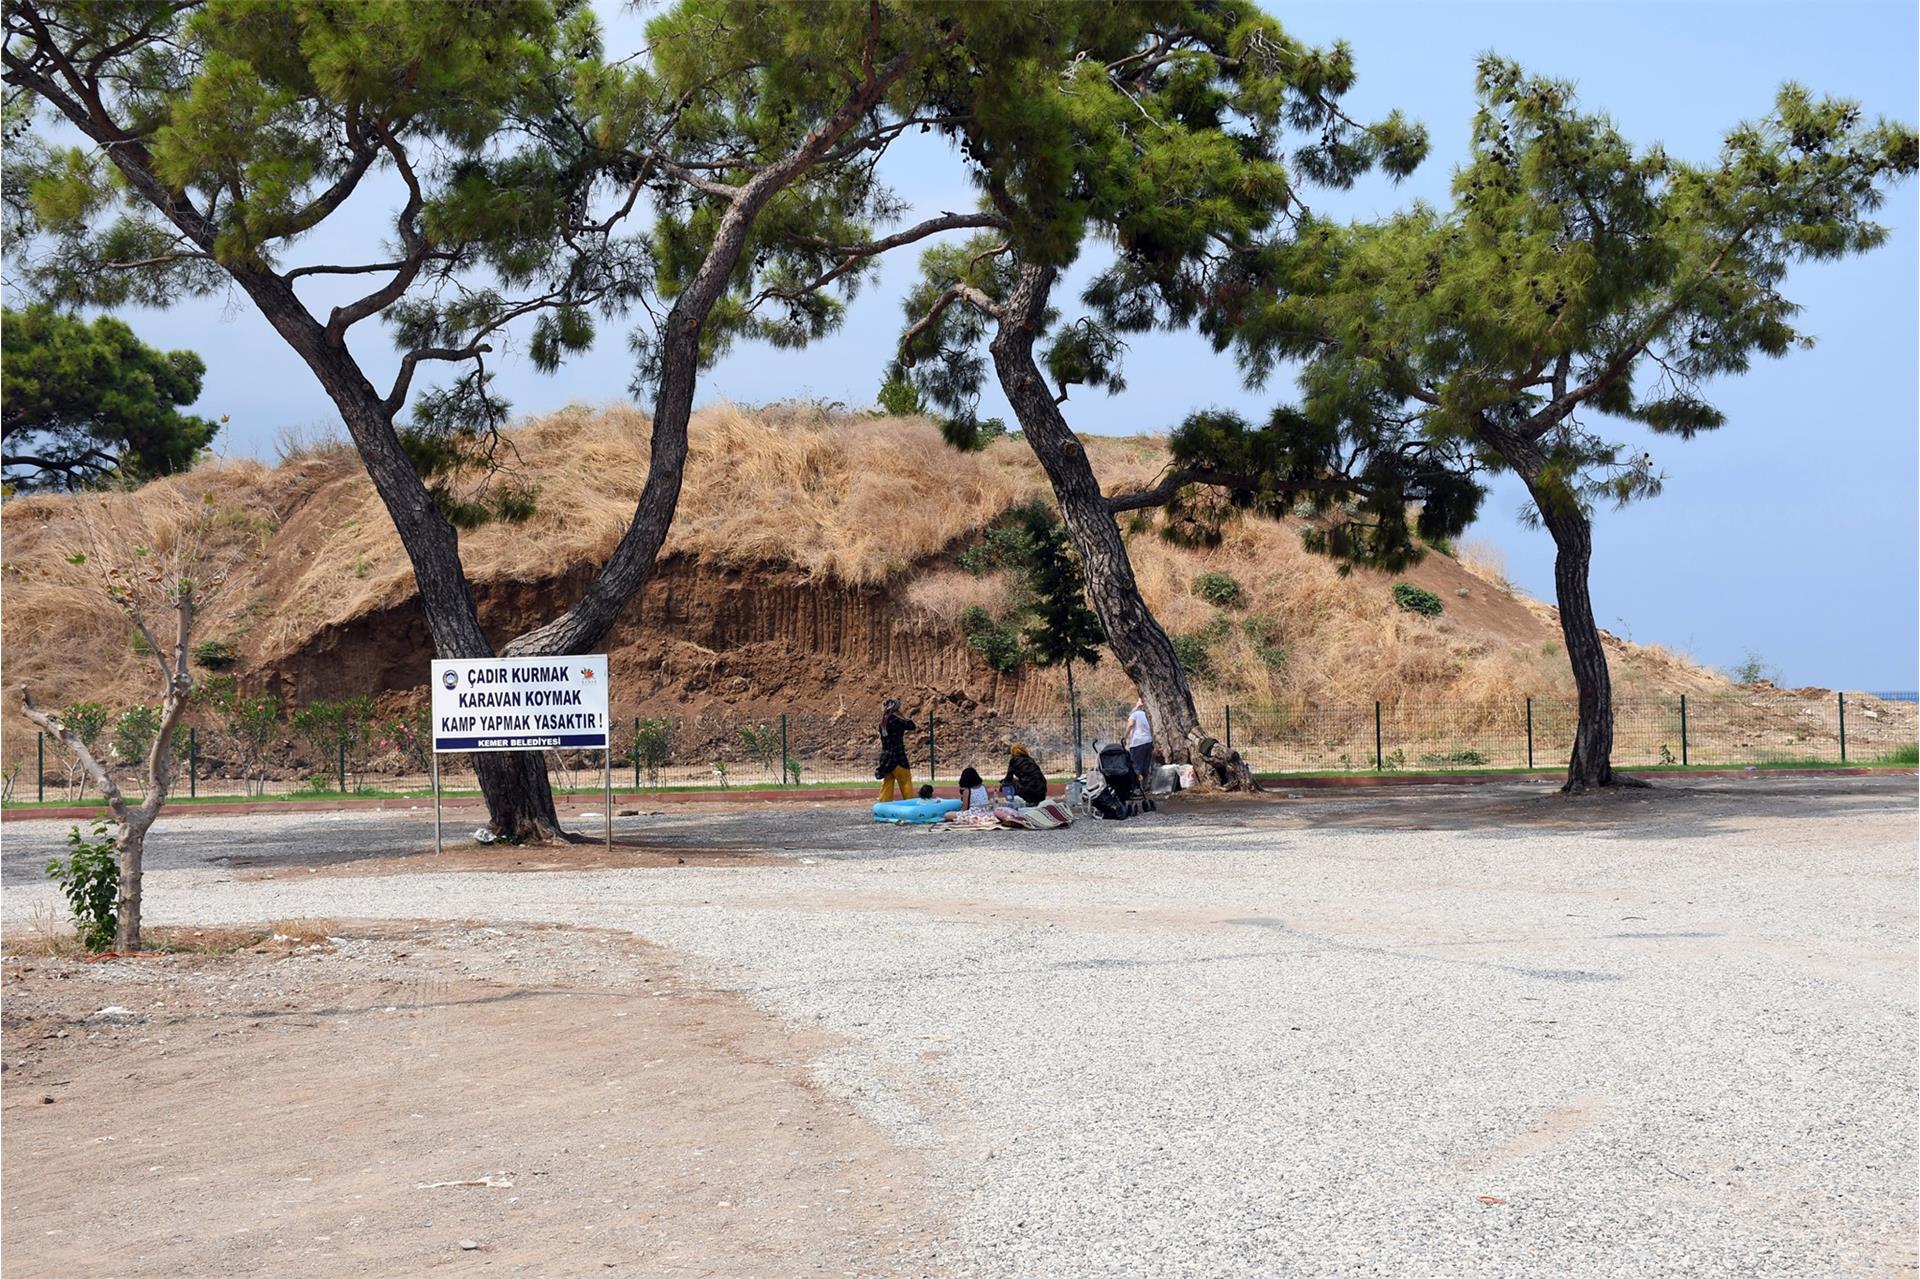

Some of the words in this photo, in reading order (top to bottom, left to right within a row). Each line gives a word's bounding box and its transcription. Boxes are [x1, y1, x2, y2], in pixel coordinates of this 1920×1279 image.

[467, 668, 508, 688] ÇADIR
[511, 666, 569, 683] KURMAK
[459, 692, 521, 708] KARAVAN
[525, 690, 582, 707] KOYMAK
[441, 717, 476, 732] KAMP
[480, 715, 531, 731] YAPMAK
[534, 713, 596, 730] YASAKTIR
[478, 739, 508, 747] KEMER
[510, 737, 561, 746] BELEDİYESİ
